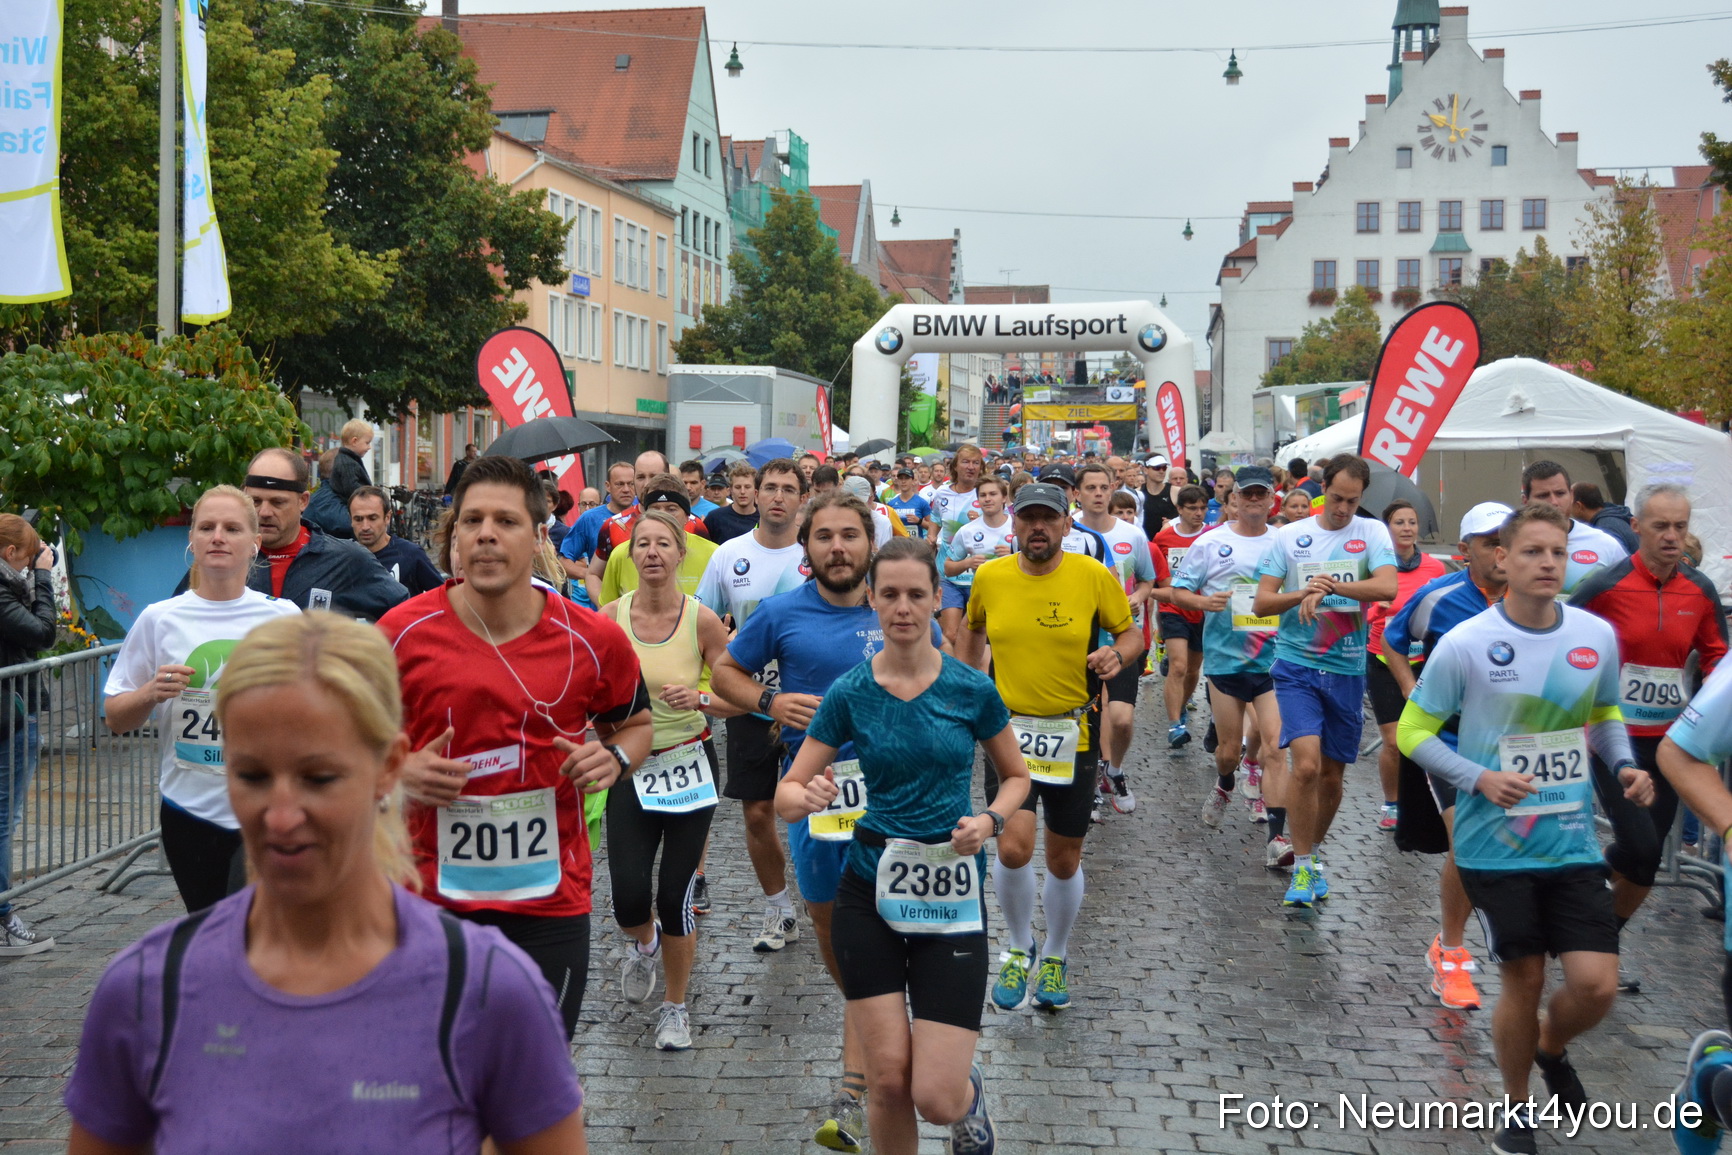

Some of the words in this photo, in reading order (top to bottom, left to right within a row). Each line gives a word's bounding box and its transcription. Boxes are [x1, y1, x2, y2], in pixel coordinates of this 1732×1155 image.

[913, 314, 987, 336] BMW
[995, 313, 1127, 340] Laufsport
[1369, 325, 1464, 472] REWE
[1067, 408, 1092, 417] ZIEL
[1161, 391, 1183, 459] REWE
[1321, 597, 1347, 606] atthias
[1245, 617, 1272, 625] Thomas
[1571, 652, 1597, 663] Hervis
[1625, 679, 1682, 705] 2099
[1635, 708, 1665, 719] Robert
[182, 709, 221, 741] 24
[1038, 721, 1072, 730] BOCK
[1020, 732, 1064, 758] 267
[1541, 732, 1580, 746] BOCK
[1027, 761, 1051, 774] Bernd
[1512, 749, 1582, 782] 2452
[643, 760, 703, 794] 2131
[490, 794, 546, 812] BOCK
[657, 792, 699, 806] Manuela
[1538, 791, 1566, 803] Timo
[839, 817, 855, 829] Fra
[451, 817, 548, 861] 2012
[889, 862, 971, 896] 2389
[900, 904, 958, 920] Veronika
